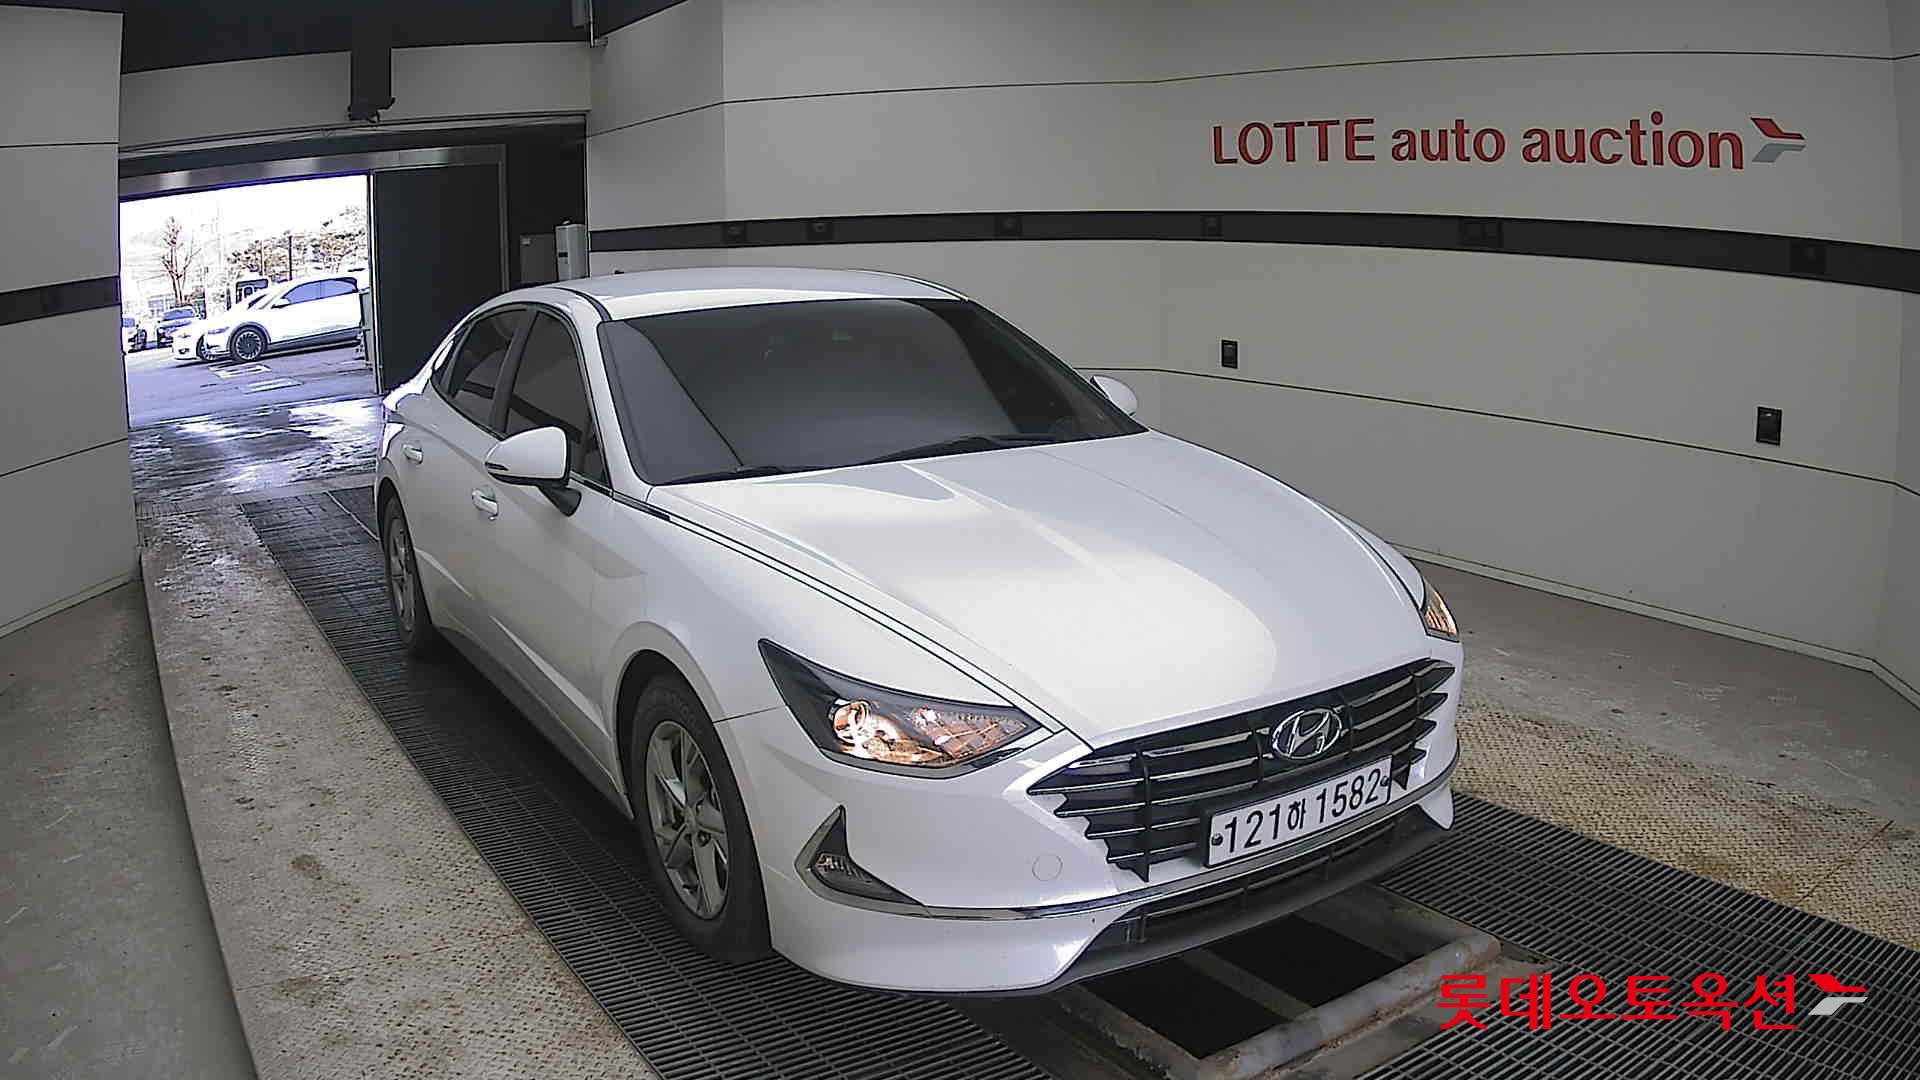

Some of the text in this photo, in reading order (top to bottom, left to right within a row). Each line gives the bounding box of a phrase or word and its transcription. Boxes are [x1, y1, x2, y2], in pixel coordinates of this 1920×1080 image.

[1213, 111, 1744, 170] LOTTE auto auction
[1225, 768, 1381, 853] 121하 1582
